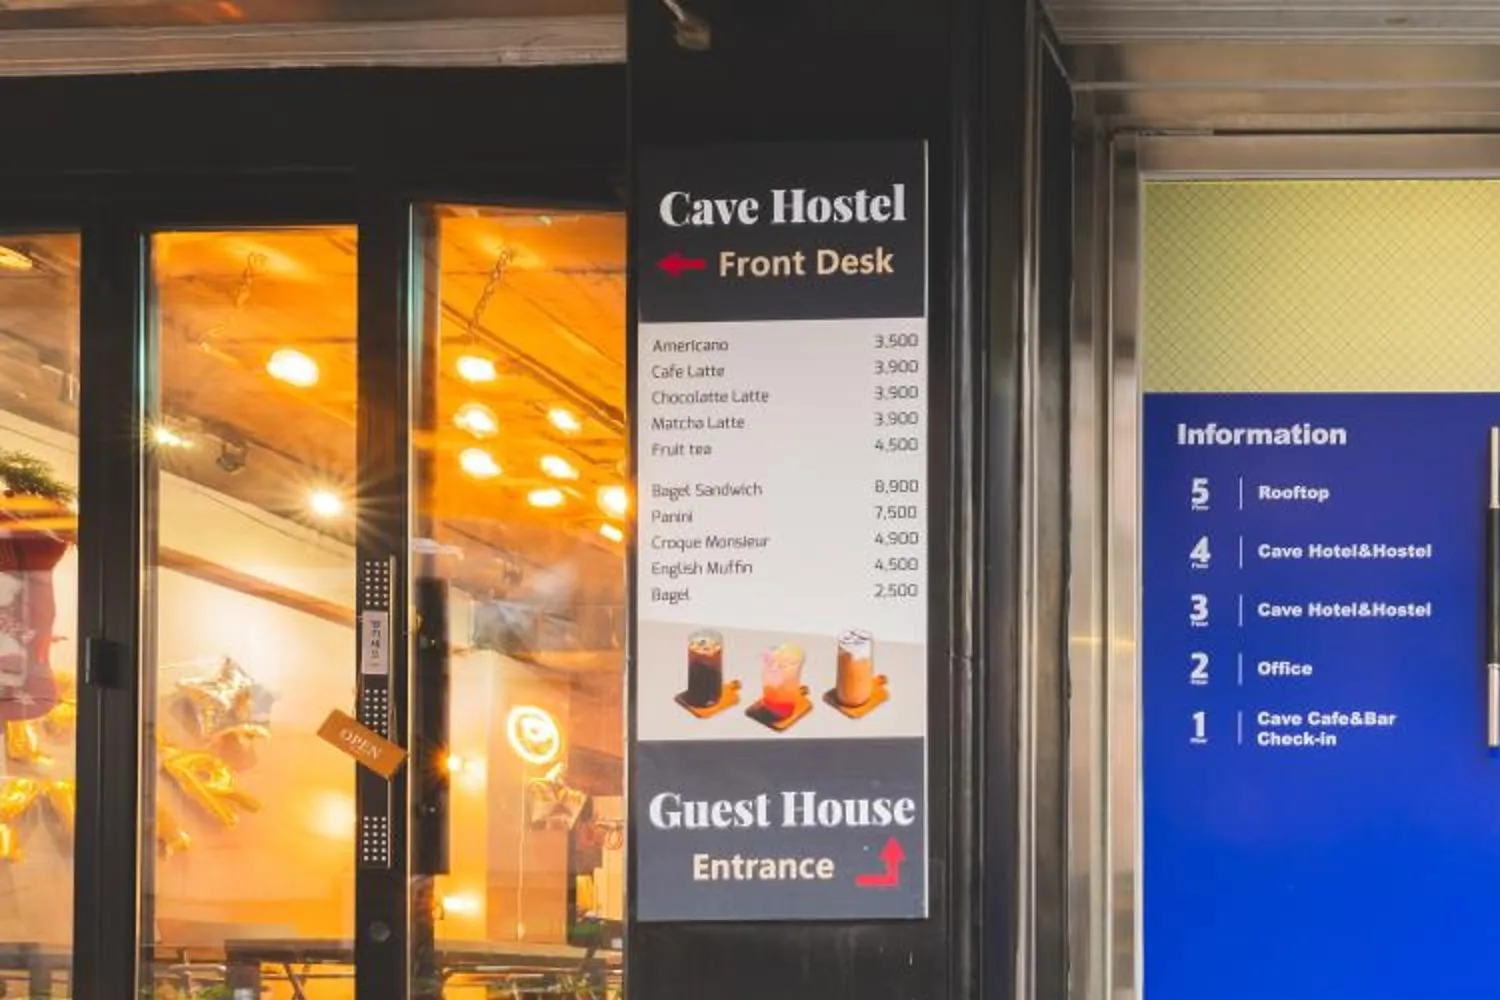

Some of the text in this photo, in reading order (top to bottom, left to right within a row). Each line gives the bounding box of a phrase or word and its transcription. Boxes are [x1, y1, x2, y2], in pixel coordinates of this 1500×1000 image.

[659, 183, 907, 227] Cave Hostel
[719, 246, 895, 277] Front Desk
[652, 339, 730, 353] Americano
[650, 364, 684, 379] Cafe
[686, 364, 725, 379] Latte
[730, 390, 770, 404] Latte
[651, 416, 705, 431] Matcha
[706, 416, 746, 430] Latte
[1177, 422, 1347, 446] Information
[651, 442, 685, 457] Fruit
[688, 443, 713, 456] tea
[651, 483, 691, 503] Bagel
[695, 481, 763, 498] Sandwich
[1190, 476, 1330, 504] 5 Rooftop
[651, 509, 693, 524] Panini
[650, 536, 702, 553] Croque
[704, 534, 770, 549] Monsieur
[1189, 535, 1432, 562] 4 Cave Hotel&Hostel
[650, 561, 703, 580] English
[706, 559, 753, 575] Muffin
[651, 586, 690, 606] Bagel
[1189, 593, 1432, 621] 3 Cave Hotel&Hostel
[1190, 652, 1313, 679] 2 Office
[1192, 711, 1397, 737] 1 Cave Cafe&Bar
[339, 728, 381, 760] OPEN
[1257, 731, 1337, 747] Check-in
[649, 791, 916, 830] Guest House
[693, 853, 835, 881] Entrance
